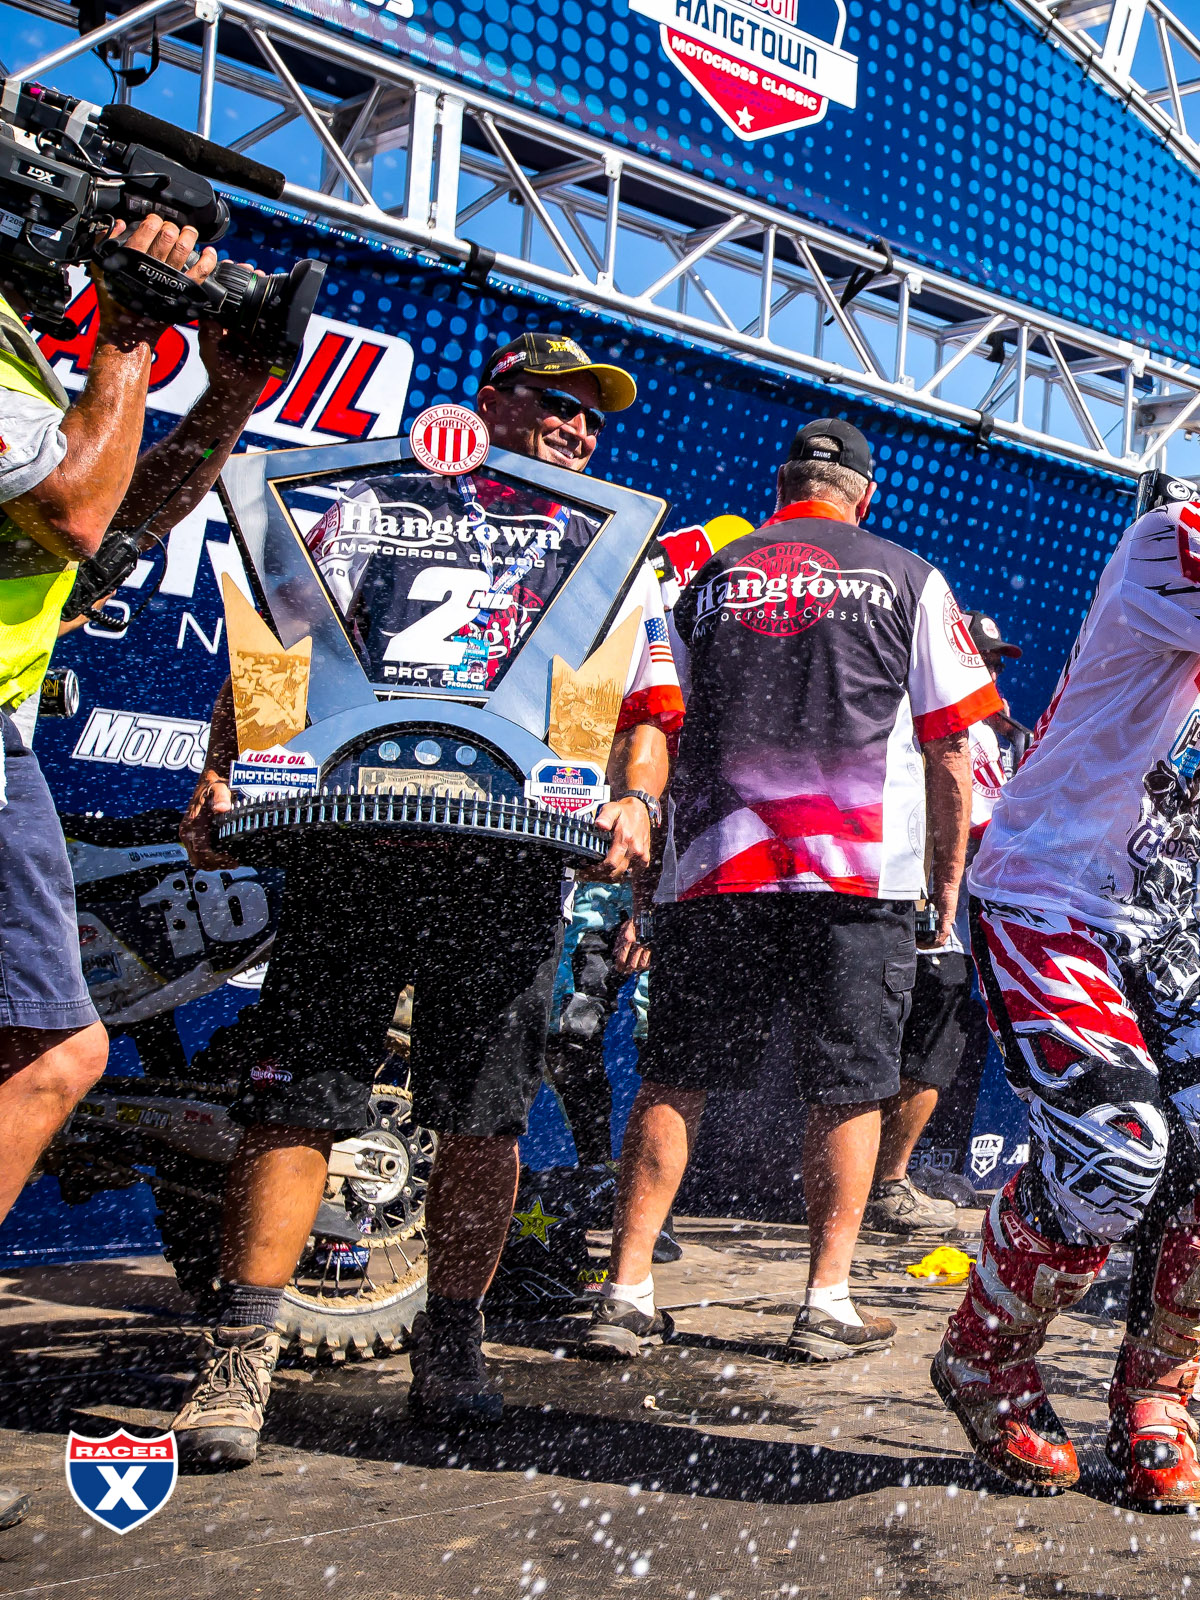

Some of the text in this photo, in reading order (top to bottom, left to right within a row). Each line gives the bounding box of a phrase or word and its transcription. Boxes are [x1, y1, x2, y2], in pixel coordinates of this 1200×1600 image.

[672, 35, 759, 86] MOTOCROSS
[761, 76, 818, 111] CLASSIC
[26, 165, 57, 185] LDX
[137, 263, 188, 292] FUJINON
[253, 331, 388, 440] IL
[419, 408, 482, 431] DIRT DIGGERS
[435, 418, 467, 430] NORTH
[414, 437, 485, 471] MOTORCYCLE CLUB
[340, 498, 565, 551] Hangtown
[341, 541, 545, 569] MOTOCROSS CLASSIC
[695, 570, 897, 619] Hangtown
[803, 606, 877, 629] Classic
[383, 665, 428, 680] PRO
[447, 680, 485, 690] PROMOTER
[246, 753, 306, 765] LUCAS OIL
[233, 769, 317, 783] MOTOCROSS
[552, 775, 584, 785] Red Bull
[543, 785, 591, 796] HANGTOWN
